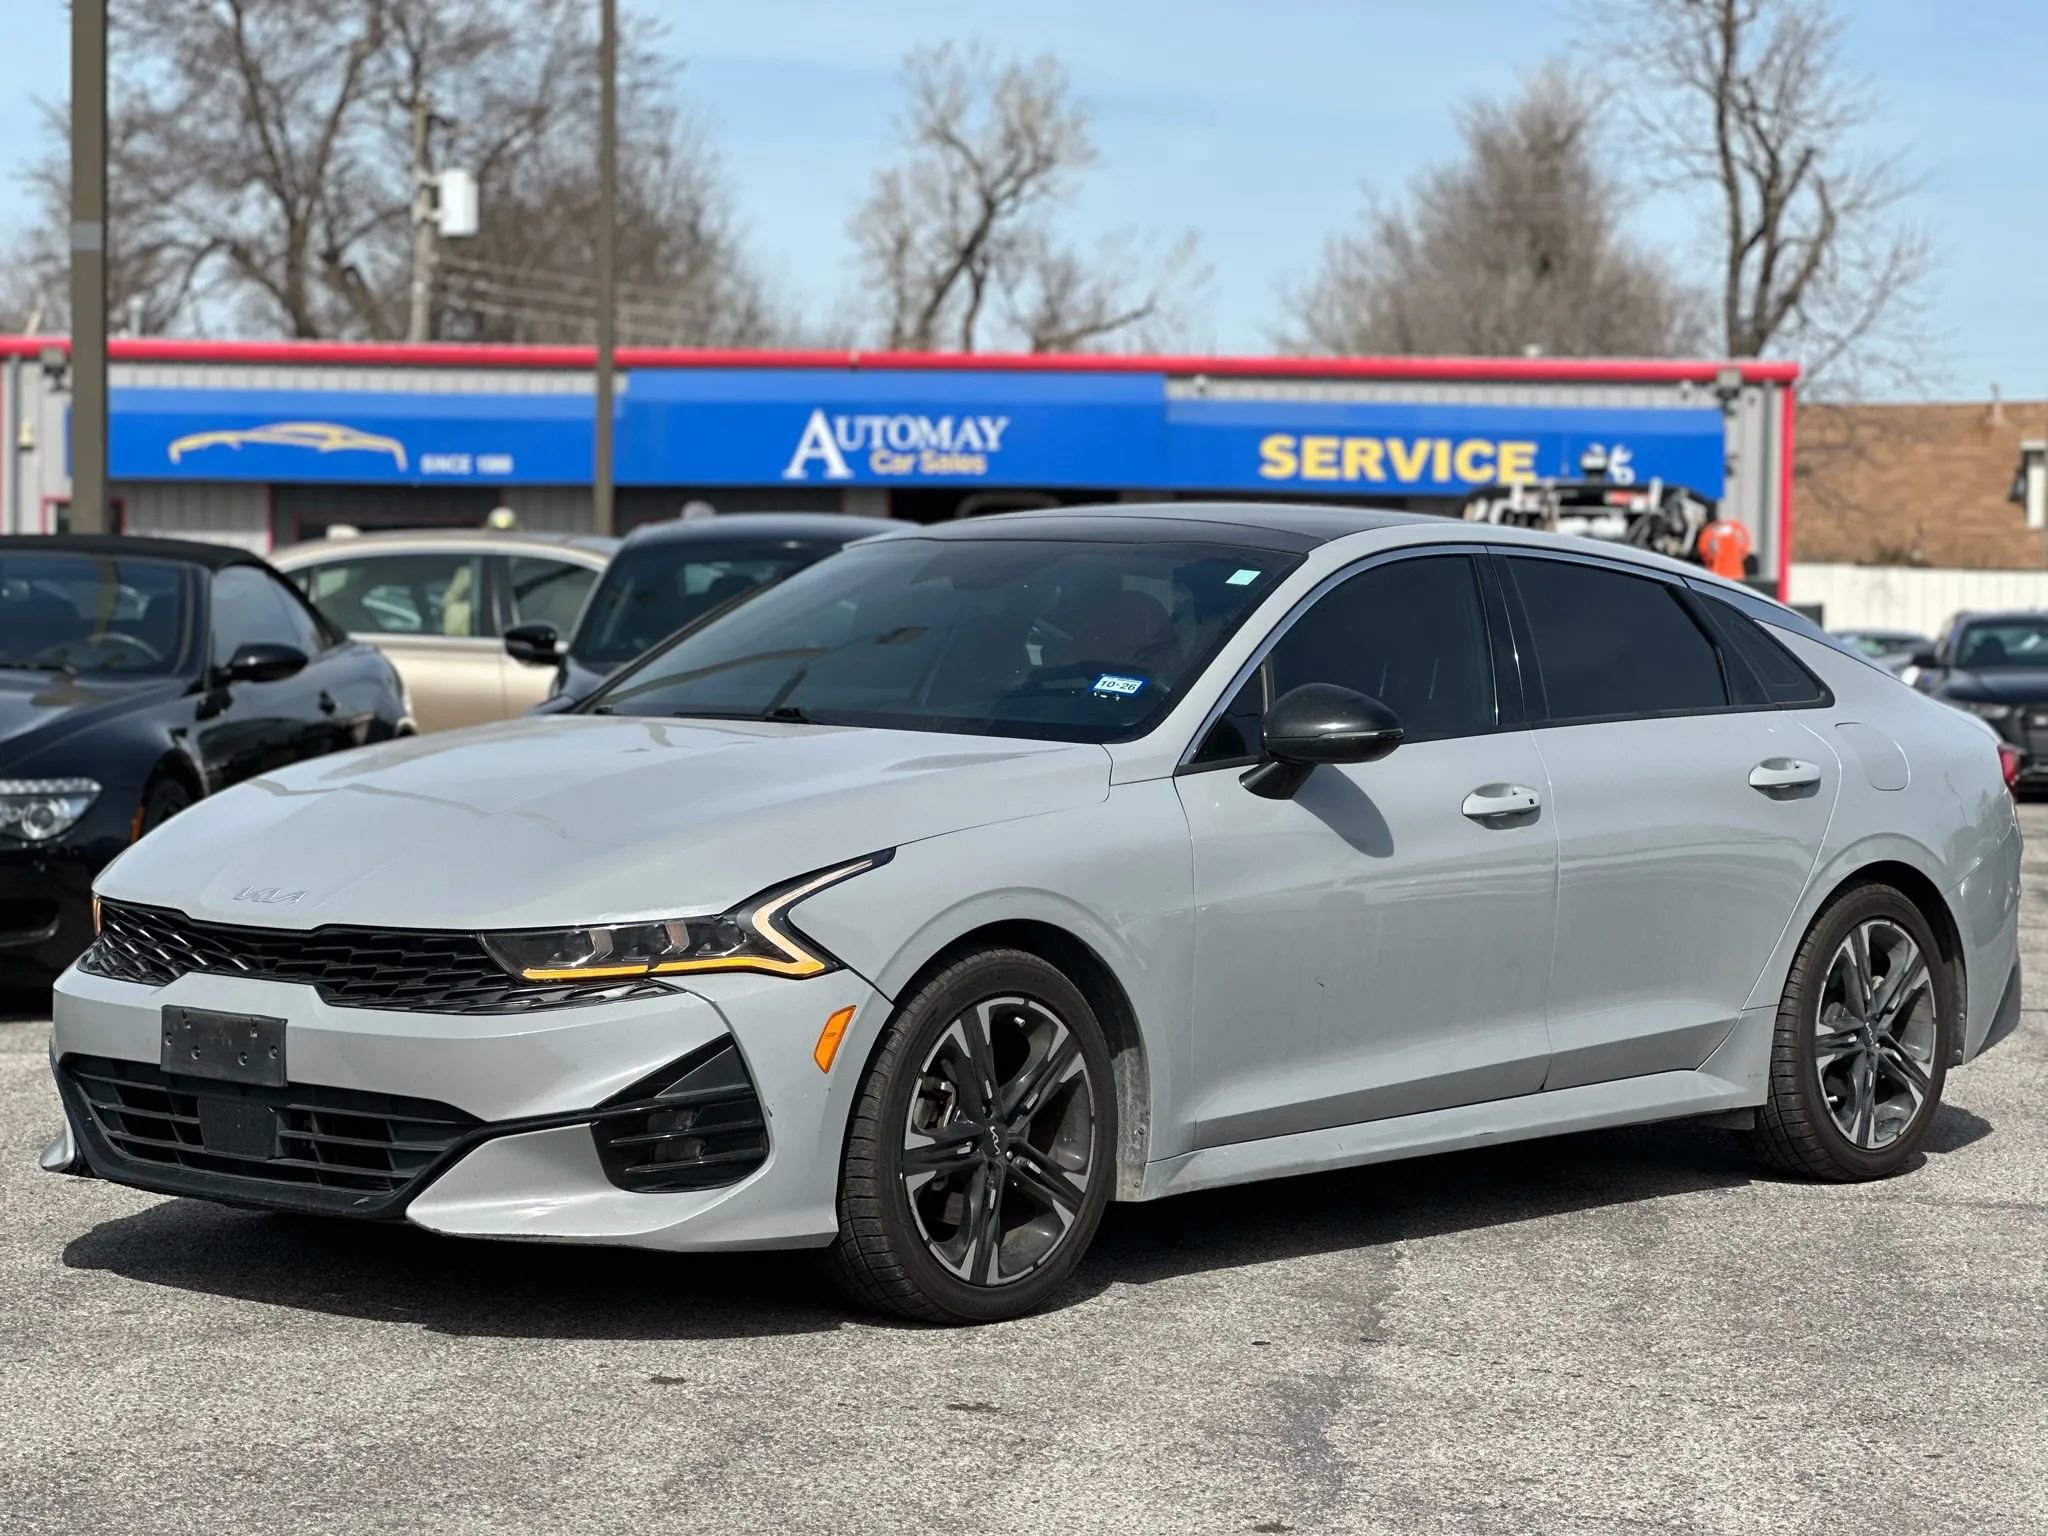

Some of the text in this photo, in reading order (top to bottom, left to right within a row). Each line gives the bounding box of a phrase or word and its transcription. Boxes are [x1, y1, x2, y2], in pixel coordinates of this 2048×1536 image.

[870, 449, 988, 475] Car Sales
[1258, 434, 1538, 484] SERVICE
[232, 885, 309, 904] KIA
